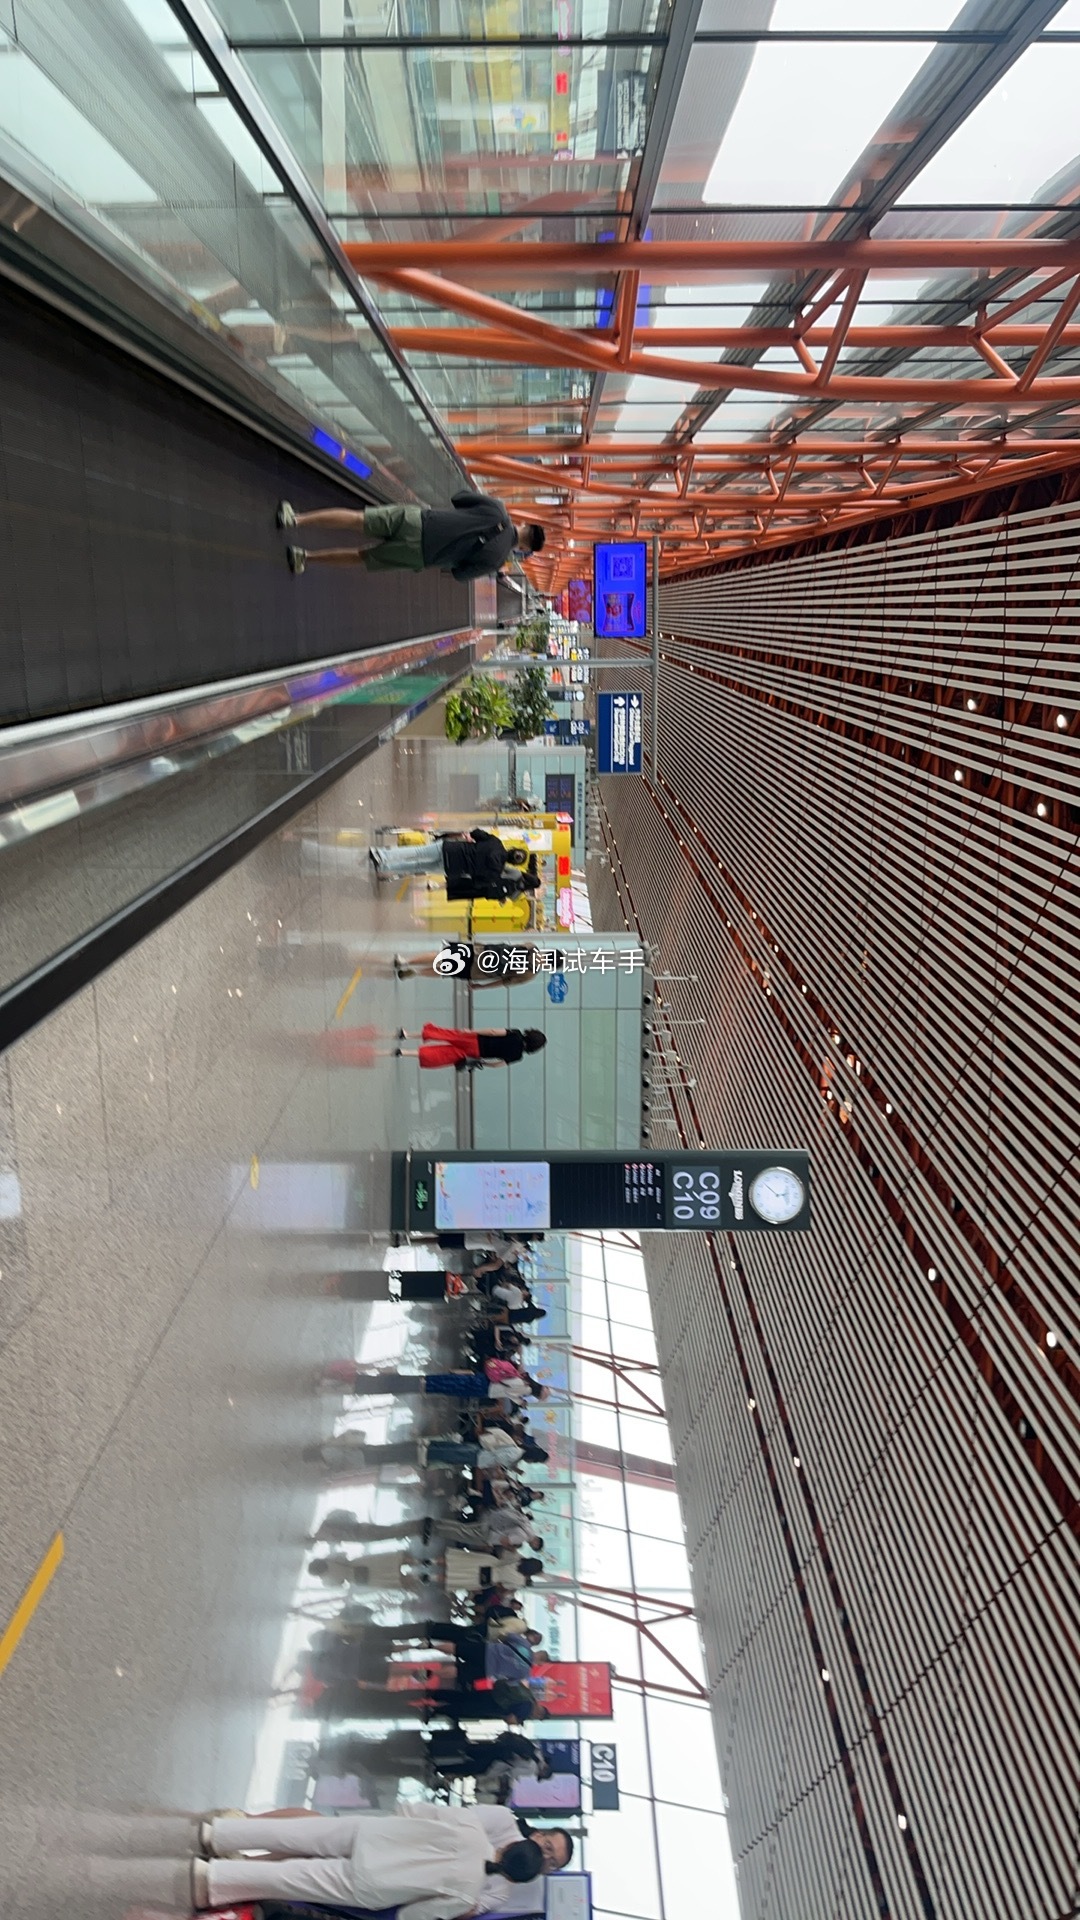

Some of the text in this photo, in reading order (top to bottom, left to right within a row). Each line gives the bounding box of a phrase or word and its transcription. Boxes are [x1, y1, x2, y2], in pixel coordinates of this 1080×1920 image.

[672, 1172, 694, 1220] C10
[699, 1172, 720, 1220] C09
[732, 1170, 744, 1220] LONGINES
[592, 1745, 616, 1782] C10
